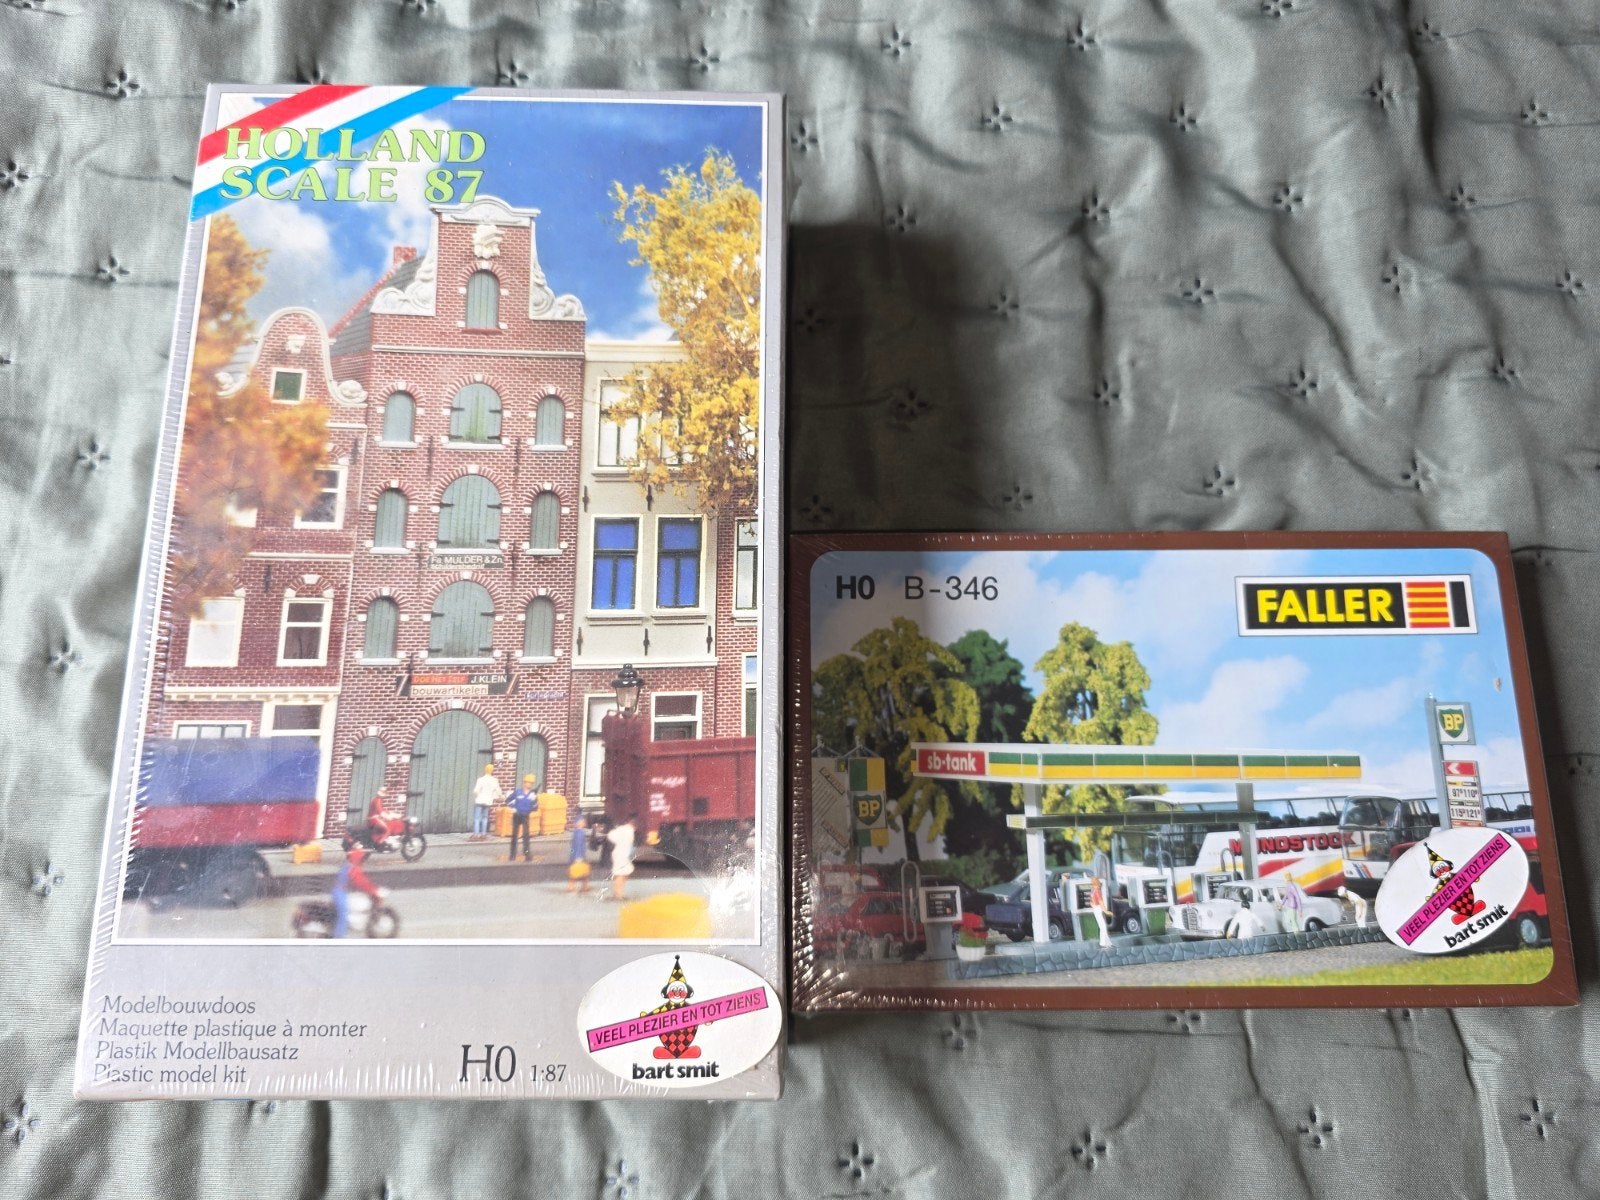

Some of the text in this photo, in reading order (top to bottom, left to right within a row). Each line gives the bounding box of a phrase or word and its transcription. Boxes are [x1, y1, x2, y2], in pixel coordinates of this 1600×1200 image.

[223, 127, 486, 162] HOLLAND
[220, 166, 485, 203] SCALE 87
[445, 556, 483, 564] MULDER
[485, 556, 491, 564] &
[905, 576, 998, 600] B-346
[1257, 589, 1394, 623] FALLER
[412, 687, 488, 696] bouwartikelen
[1443, 714, 1464, 731] BP
[927, 753, 977, 773] sb-tank
[857, 800, 881, 818] BP
[1228, 831, 1357, 856] MNDSTOCK
[1404, 917, 1426, 938] VEEL
[1423, 886, 1457, 918] PLEZIER
[1454, 875, 1467, 889] EN
[1480, 840, 1504, 865] ZIENS
[1443, 904, 1508, 948] bart smit
[102, 996, 256, 1014] Modelbouwdoos
[595, 993, 762, 1046] VEEL PLEZIER EN TOT ZIENS
[99, 1018, 367, 1042] Maquette plastique à monter
[96, 1041, 299, 1061] Plastik Modellbausatz
[94, 1064, 247, 1083] Plastic model kit
[530, 1064, 567, 1083] 1:87
[632, 1062, 720, 1080] bart smit
